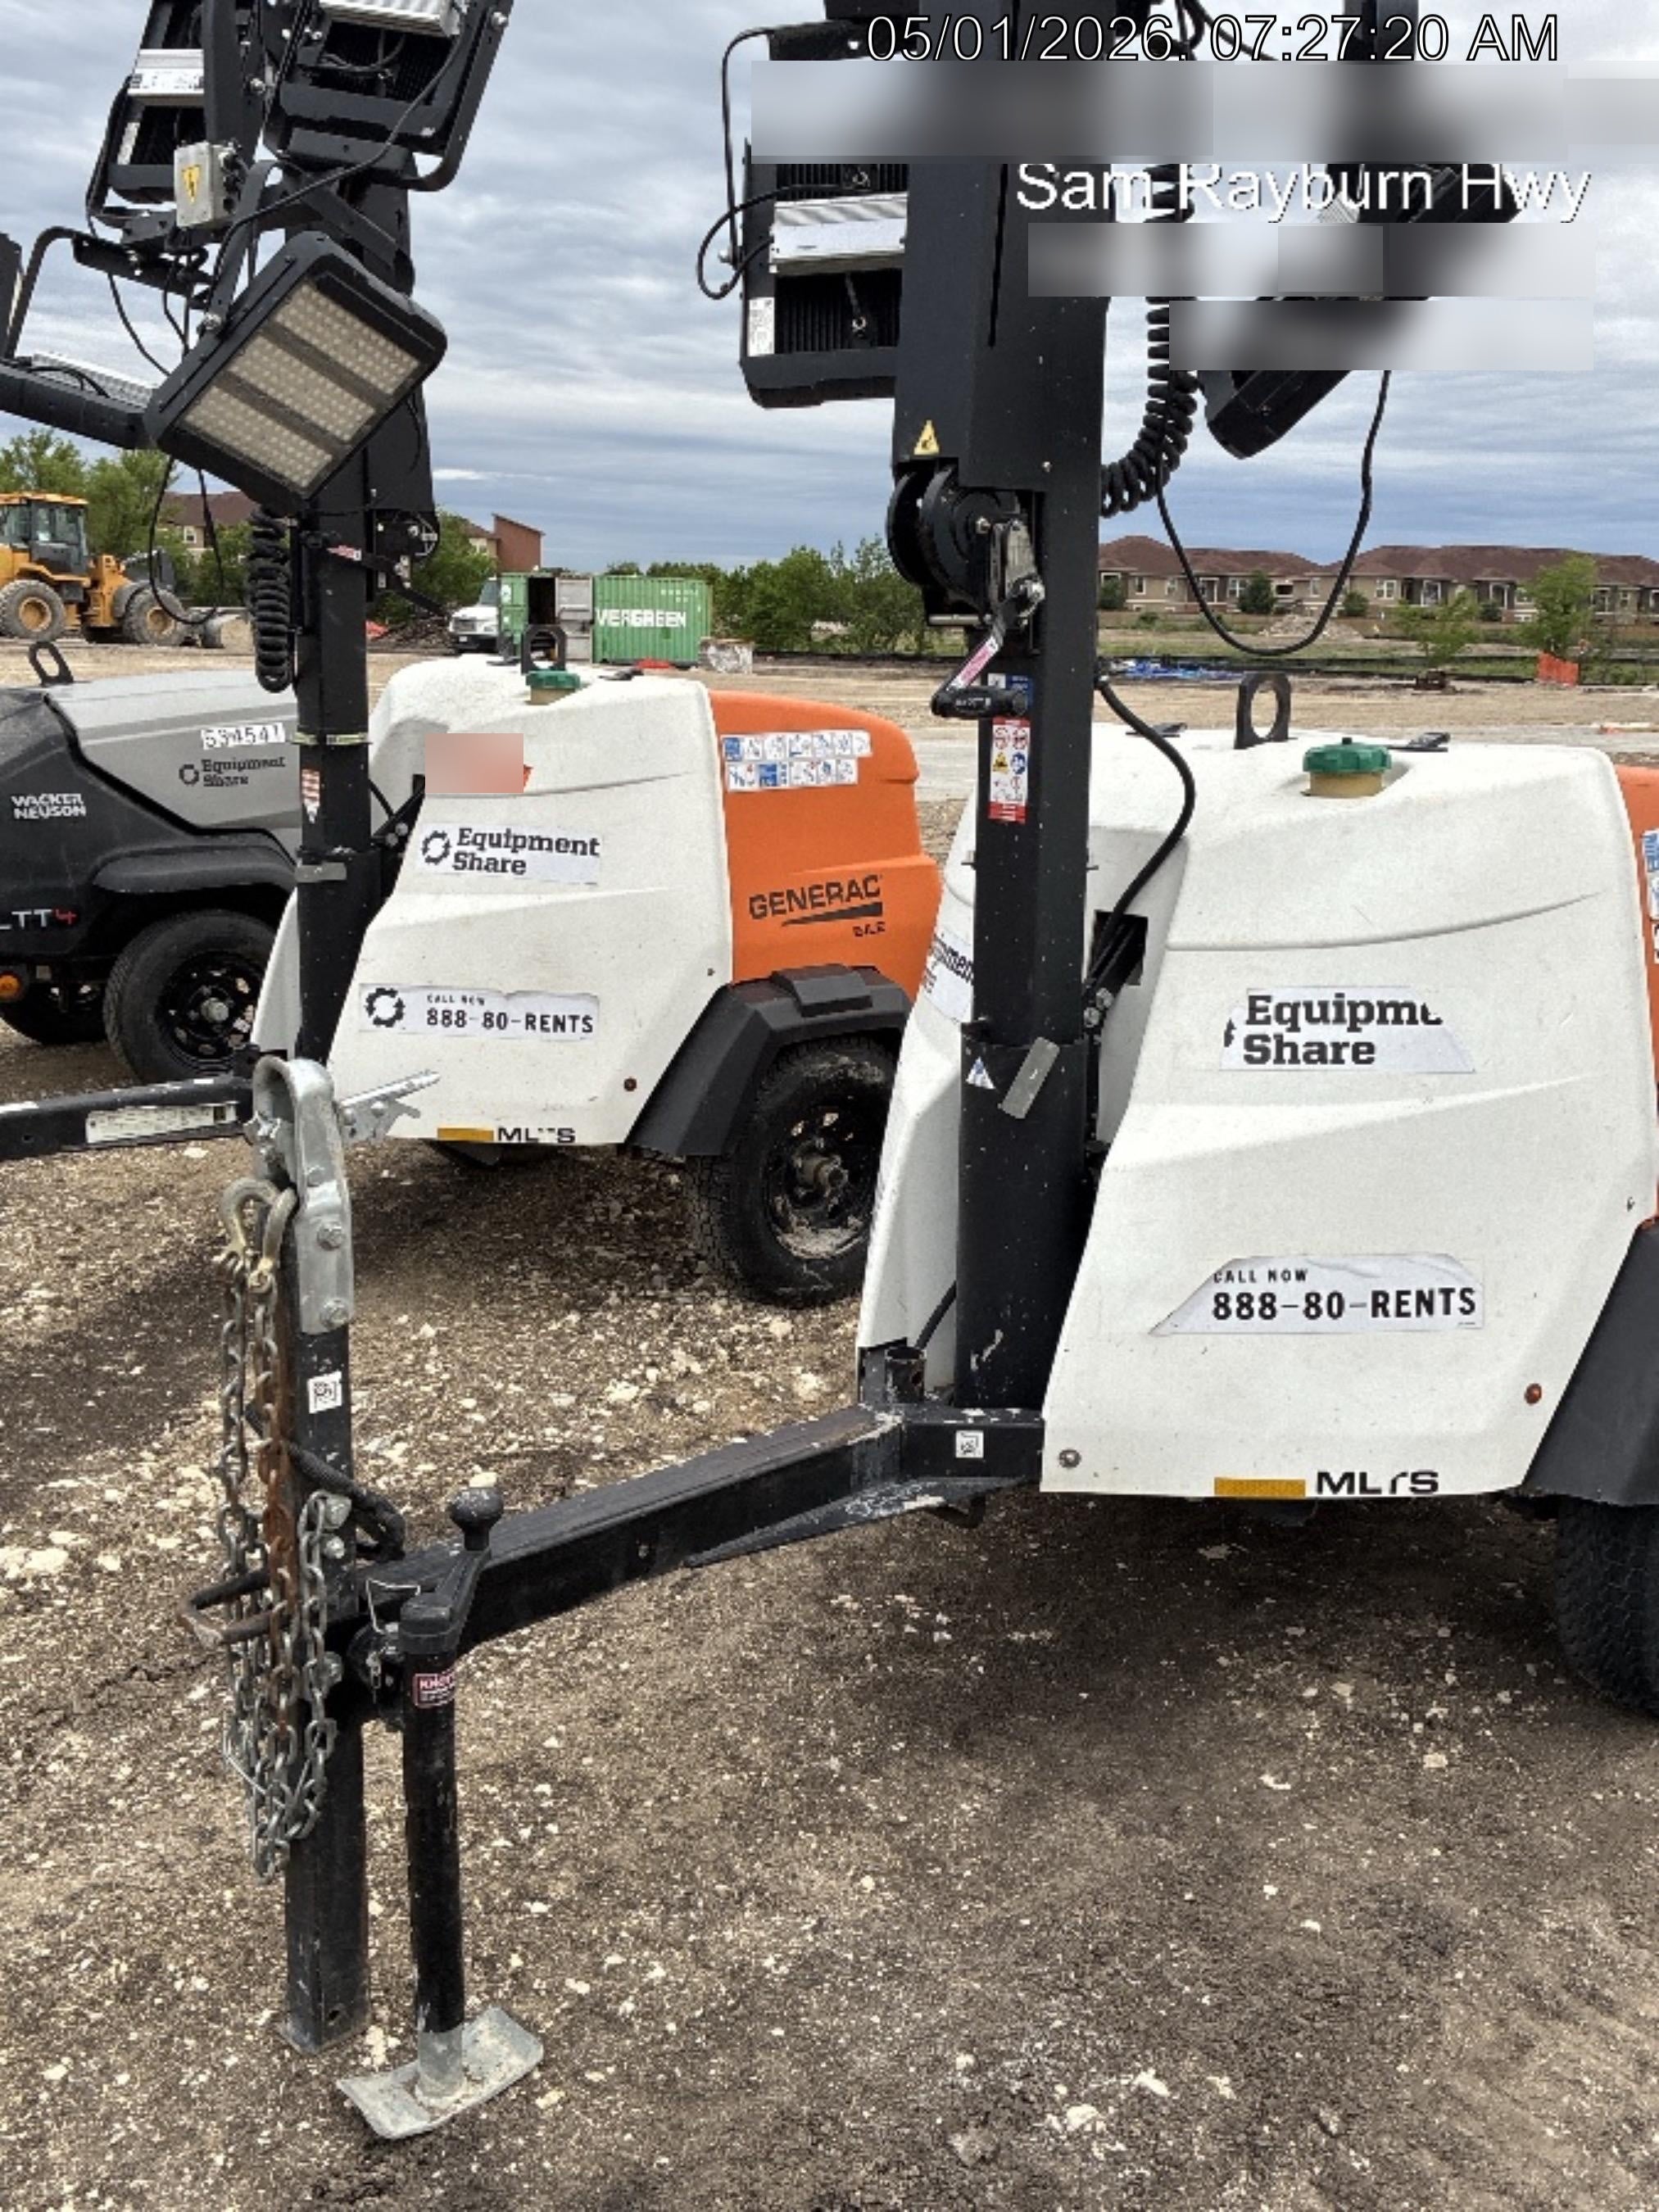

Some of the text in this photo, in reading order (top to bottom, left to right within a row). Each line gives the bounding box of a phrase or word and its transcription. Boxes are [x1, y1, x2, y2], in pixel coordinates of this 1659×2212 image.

[595, 605, 687, 628] VERGREEN
[11, 793, 84, 807] WACKER
[13, 805, 86, 819] NEUSON
[456, 827, 601, 858] Equipment
[452, 851, 527, 875] Share
[749, 873, 881, 920] GENERAC
[426, 1007, 594, 1034] 888-80-RENTS
[1244, 992, 1444, 1033] Equipm
[1243, 1033, 1376, 1065] Share
[1213, 1269, 1309, 1284] CALL NOW
[1212, 1286, 1476, 1321] 888-80-RENTS
